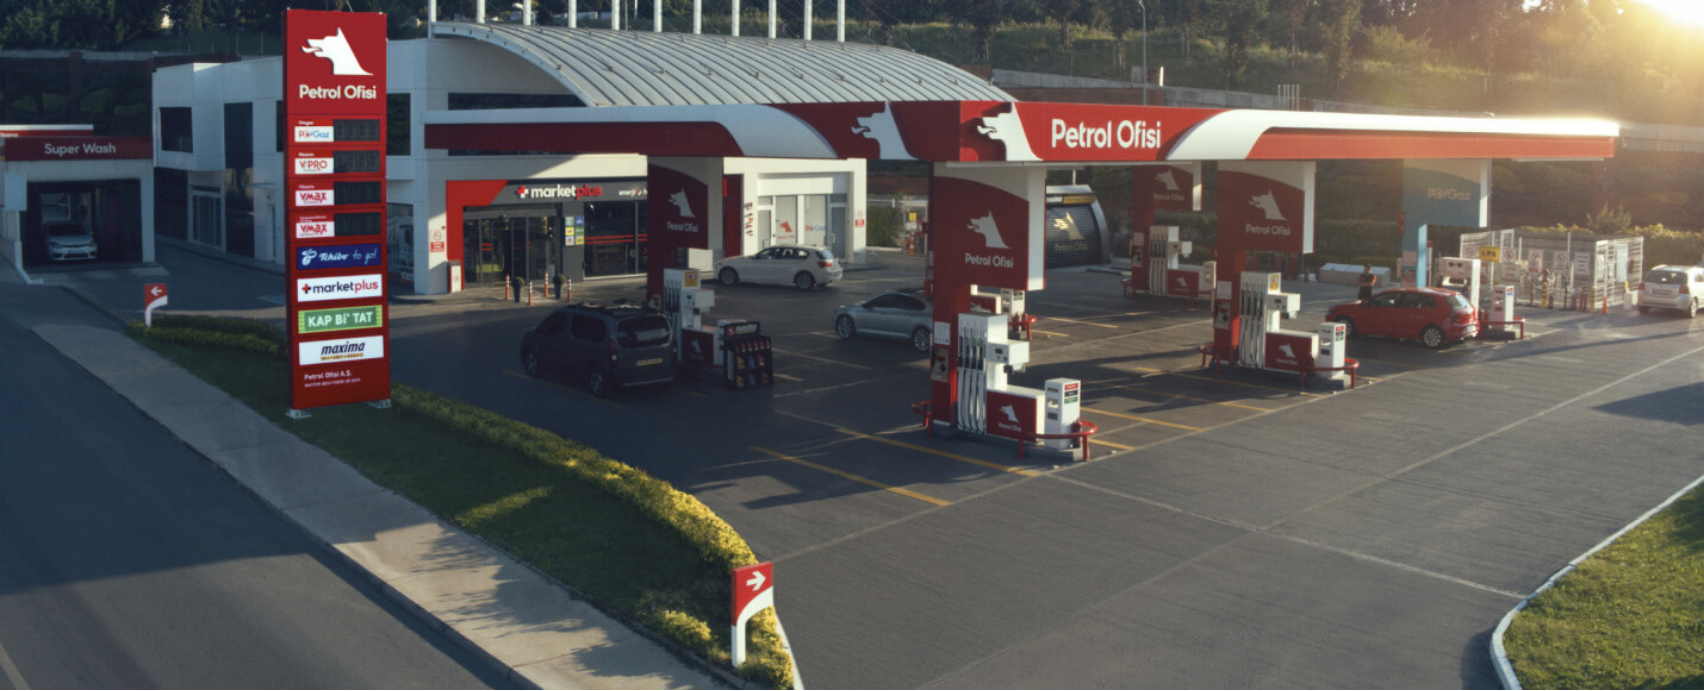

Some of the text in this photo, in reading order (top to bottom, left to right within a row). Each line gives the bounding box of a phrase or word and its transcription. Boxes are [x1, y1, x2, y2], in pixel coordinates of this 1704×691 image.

[299, 84, 377, 99] Petrol Ofisi
[1051, 118, 1161, 149] Petrol Ofisi
[44, 142, 117, 157] Super Wash
[530, 184, 603, 200] marketplus
[1245, 224, 1291, 236] Petrol Ofisi
[319, 252, 349, 261] Tchibo
[352, 249, 362, 260] to
[964, 253, 1014, 268] Petrol Ofisi
[312, 279, 379, 294] marketplus
[307, 314, 332, 327] KAP
[353, 311, 373, 323] TAT
[321, 340, 365, 355] maxima
[304, 372, 323, 381] Petrol
